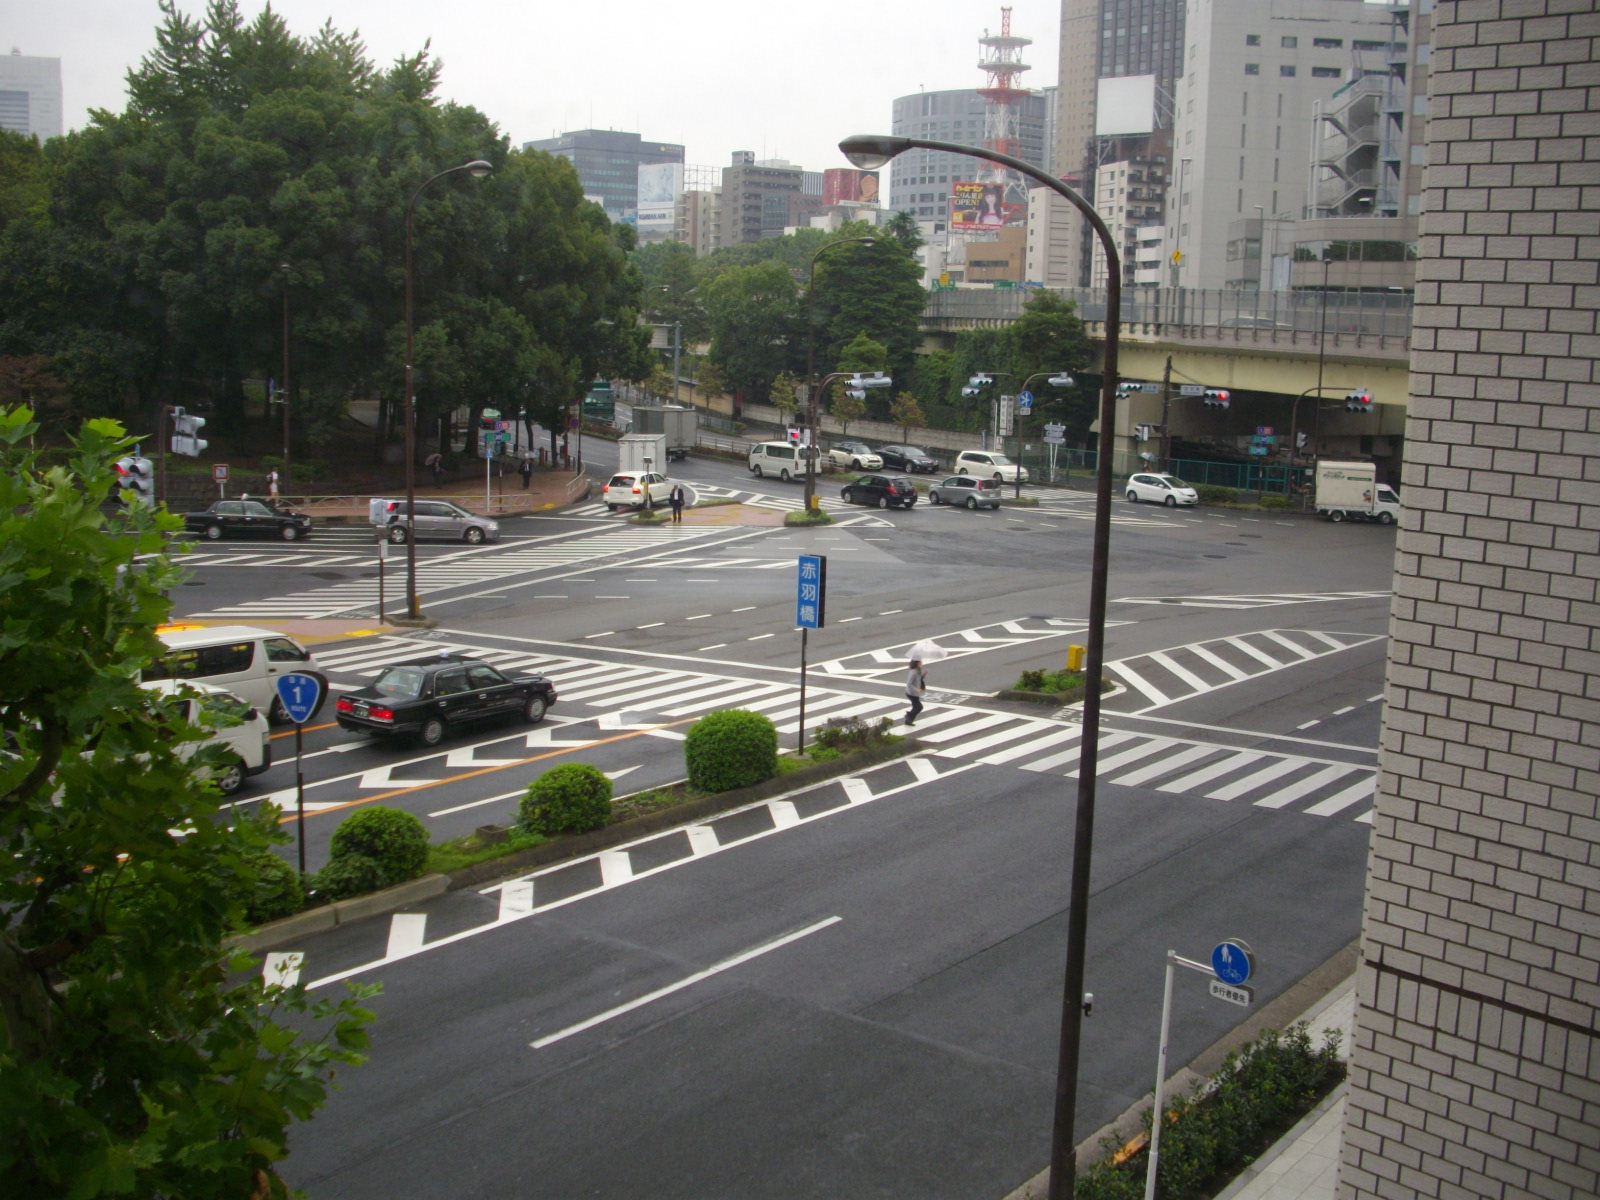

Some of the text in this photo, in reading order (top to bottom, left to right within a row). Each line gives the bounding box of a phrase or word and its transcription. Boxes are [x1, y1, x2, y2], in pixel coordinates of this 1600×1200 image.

[800, 563, 816, 623] 赤羽橋
[293, 686, 301, 703] 1
[1212, 985, 1246, 1003] 歩行者優先
